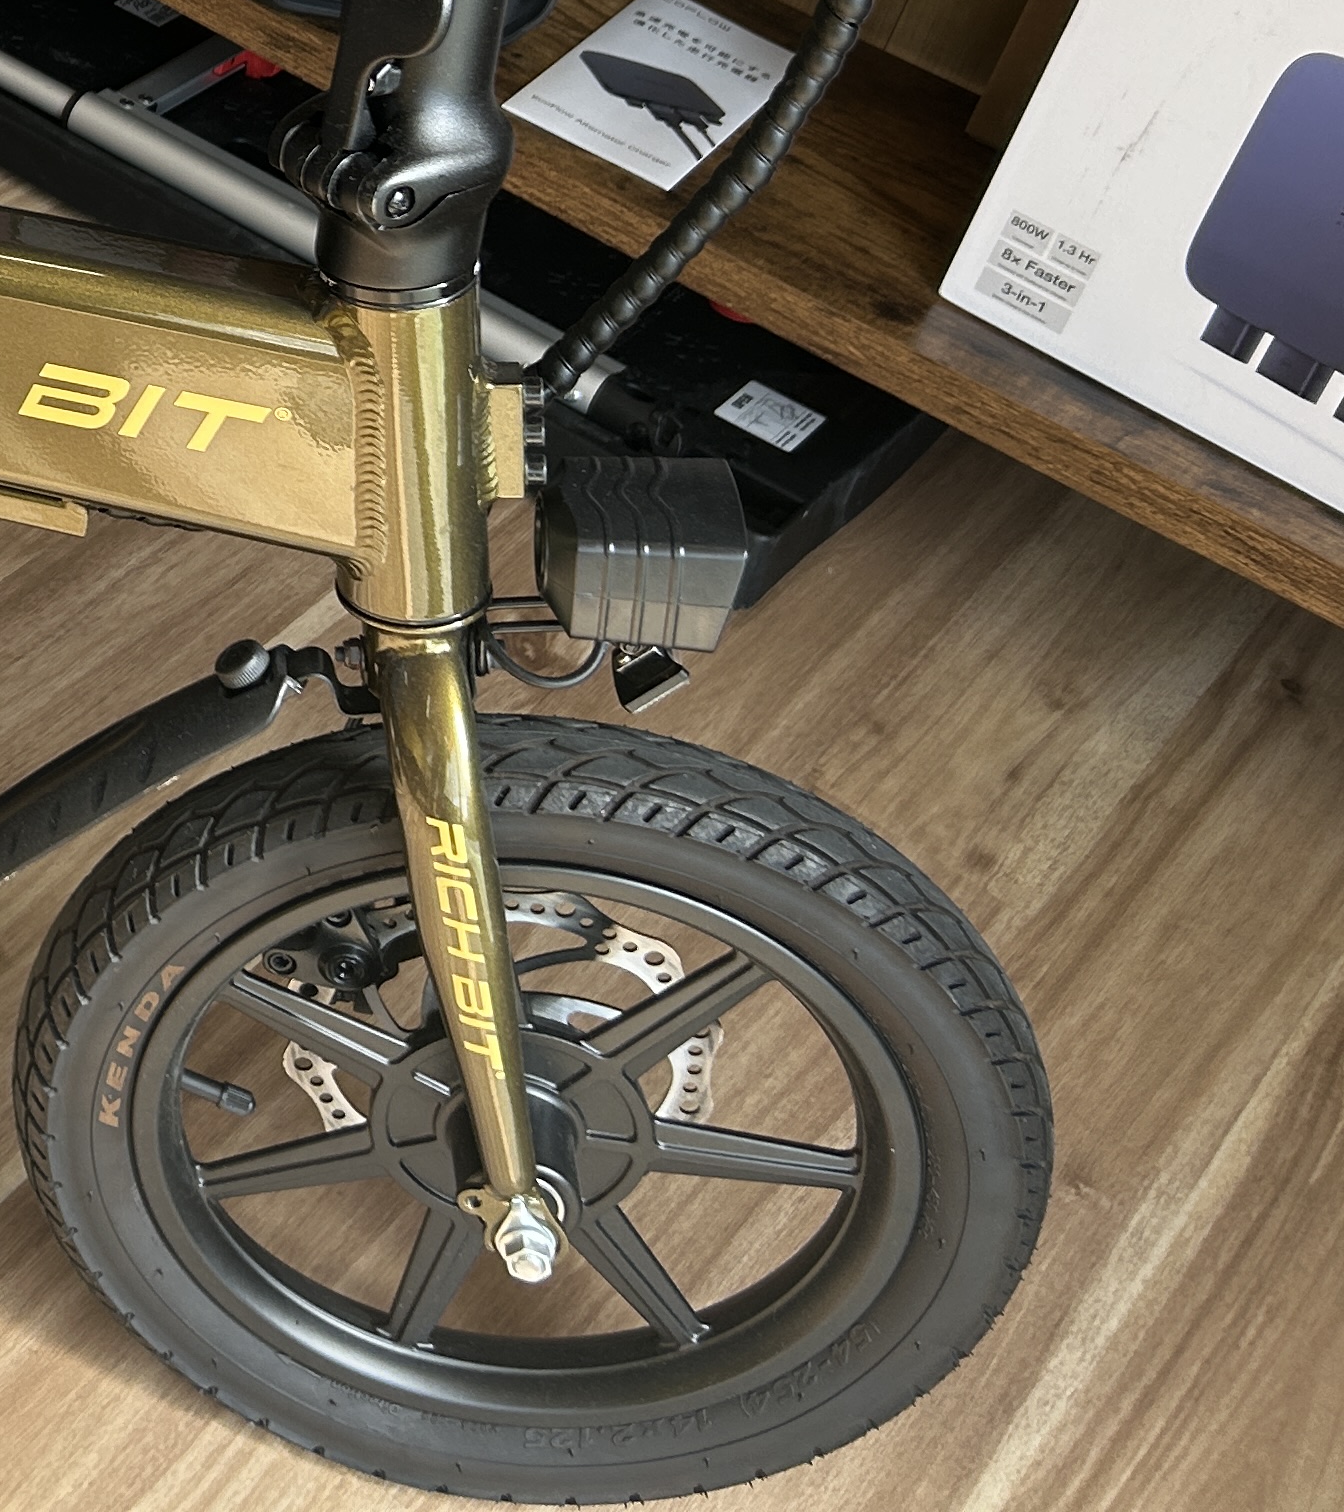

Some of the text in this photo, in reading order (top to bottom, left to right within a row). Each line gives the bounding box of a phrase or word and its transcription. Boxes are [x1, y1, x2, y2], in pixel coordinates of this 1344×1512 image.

[1011, 216, 1049, 241] 800W
[1001, 248, 1021, 266] 8x
[1024, 260, 1076, 293] Faster
[1057, 240, 1096, 265] 1.3 Hr
[1001, 282, 1046, 313] 3-in-1
[426, 816, 485, 964] RICH
[98, 964, 185, 1128] KENDA
